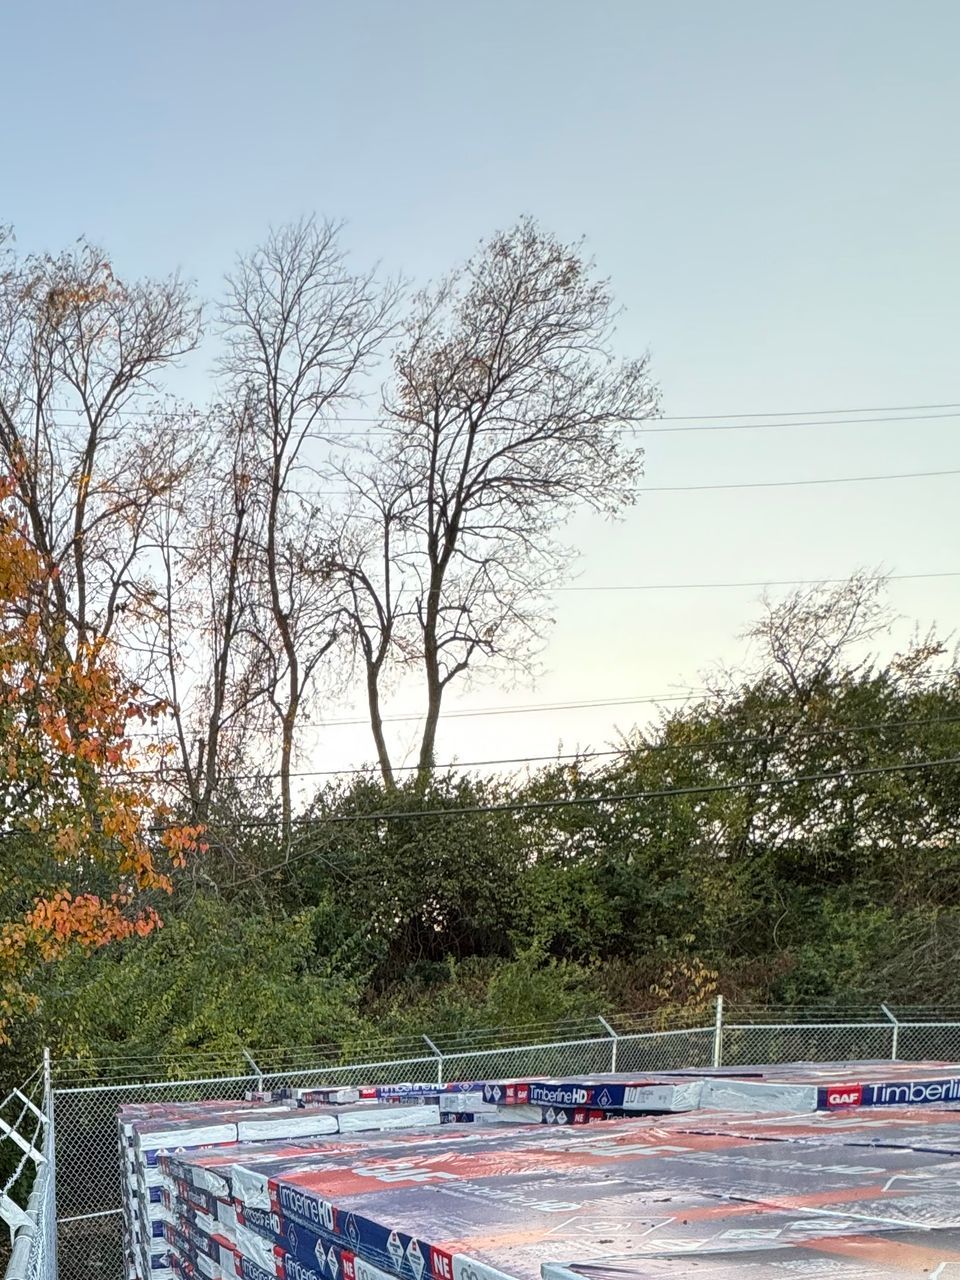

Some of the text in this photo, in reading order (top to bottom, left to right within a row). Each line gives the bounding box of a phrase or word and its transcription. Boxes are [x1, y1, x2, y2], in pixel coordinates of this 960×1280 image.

[829, 1093, 859, 1104] GAF
[869, 1080, 960, 1103] Timberli
[433, 1252, 451, 1279] NE
